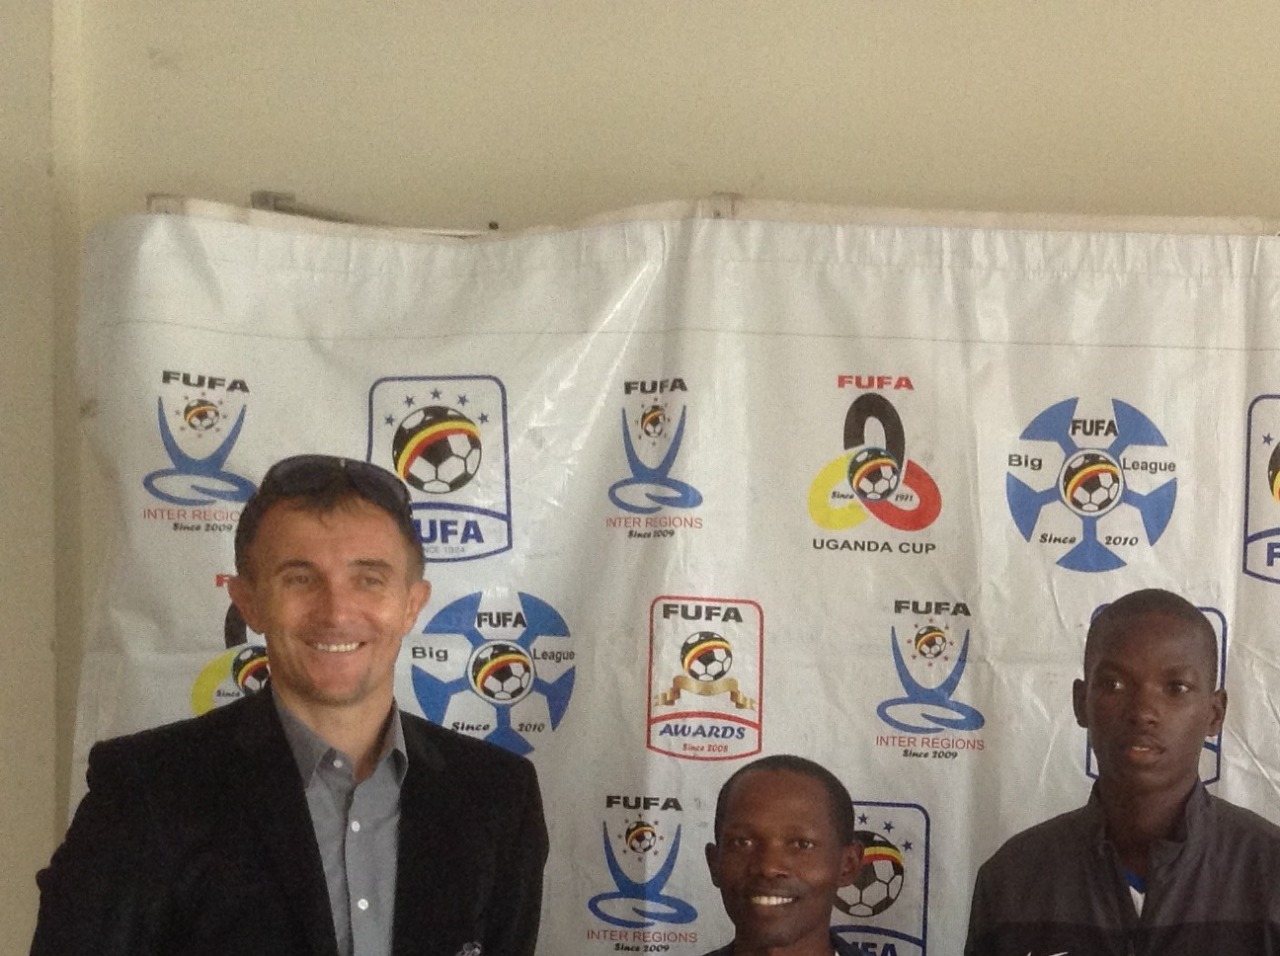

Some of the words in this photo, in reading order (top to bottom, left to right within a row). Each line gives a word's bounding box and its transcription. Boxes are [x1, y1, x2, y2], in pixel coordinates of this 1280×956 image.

[162, 370, 251, 393] FUFA
[624, 378, 688, 395] FUFA
[837, 375, 915, 390] FUFA
[1071, 419, 1119, 437] FUFA
[1008, 454, 1043, 471] Big
[1122, 457, 1176, 474] League
[831, 491, 855, 500] Since
[143, 508, 188, 521] INTER
[191, 509, 240, 522] REGIO
[606, 517, 642, 528] INTER
[645, 517, 703, 529] REGIONS
[172, 522, 202, 532] Since
[204, 522, 233, 533] 2009
[412, 519, 484, 544] UFA
[628, 529, 652, 539] Since
[813, 538, 893, 552] UGANDA
[898, 542, 936, 554] CUP
[1039, 533, 1077, 544] Since
[1104, 535, 1139, 546] 2010
[663, 604, 743, 622] FUFA
[894, 600, 971, 616] FUFA
[476, 611, 527, 628] FUFA
[411, 646, 449, 662] Big
[532, 648, 575, 663] League
[451, 721, 490, 732] Since
[518, 722, 545, 733] 2010
[659, 723, 745, 740] AWARDS
[682, 743, 705, 752] Since
[876, 735, 916, 748] INTER
[921, 736, 985, 751] REGIONS
[902, 749, 929, 758] Since
[932, 750, 958, 759] 2009
[606, 795, 683, 811] FUFA
[587, 929, 628, 941] INTER
[632, 930, 698, 943] REGIONS
[614, 943, 640, 952] Since
[643, 943, 670, 953] 2009
